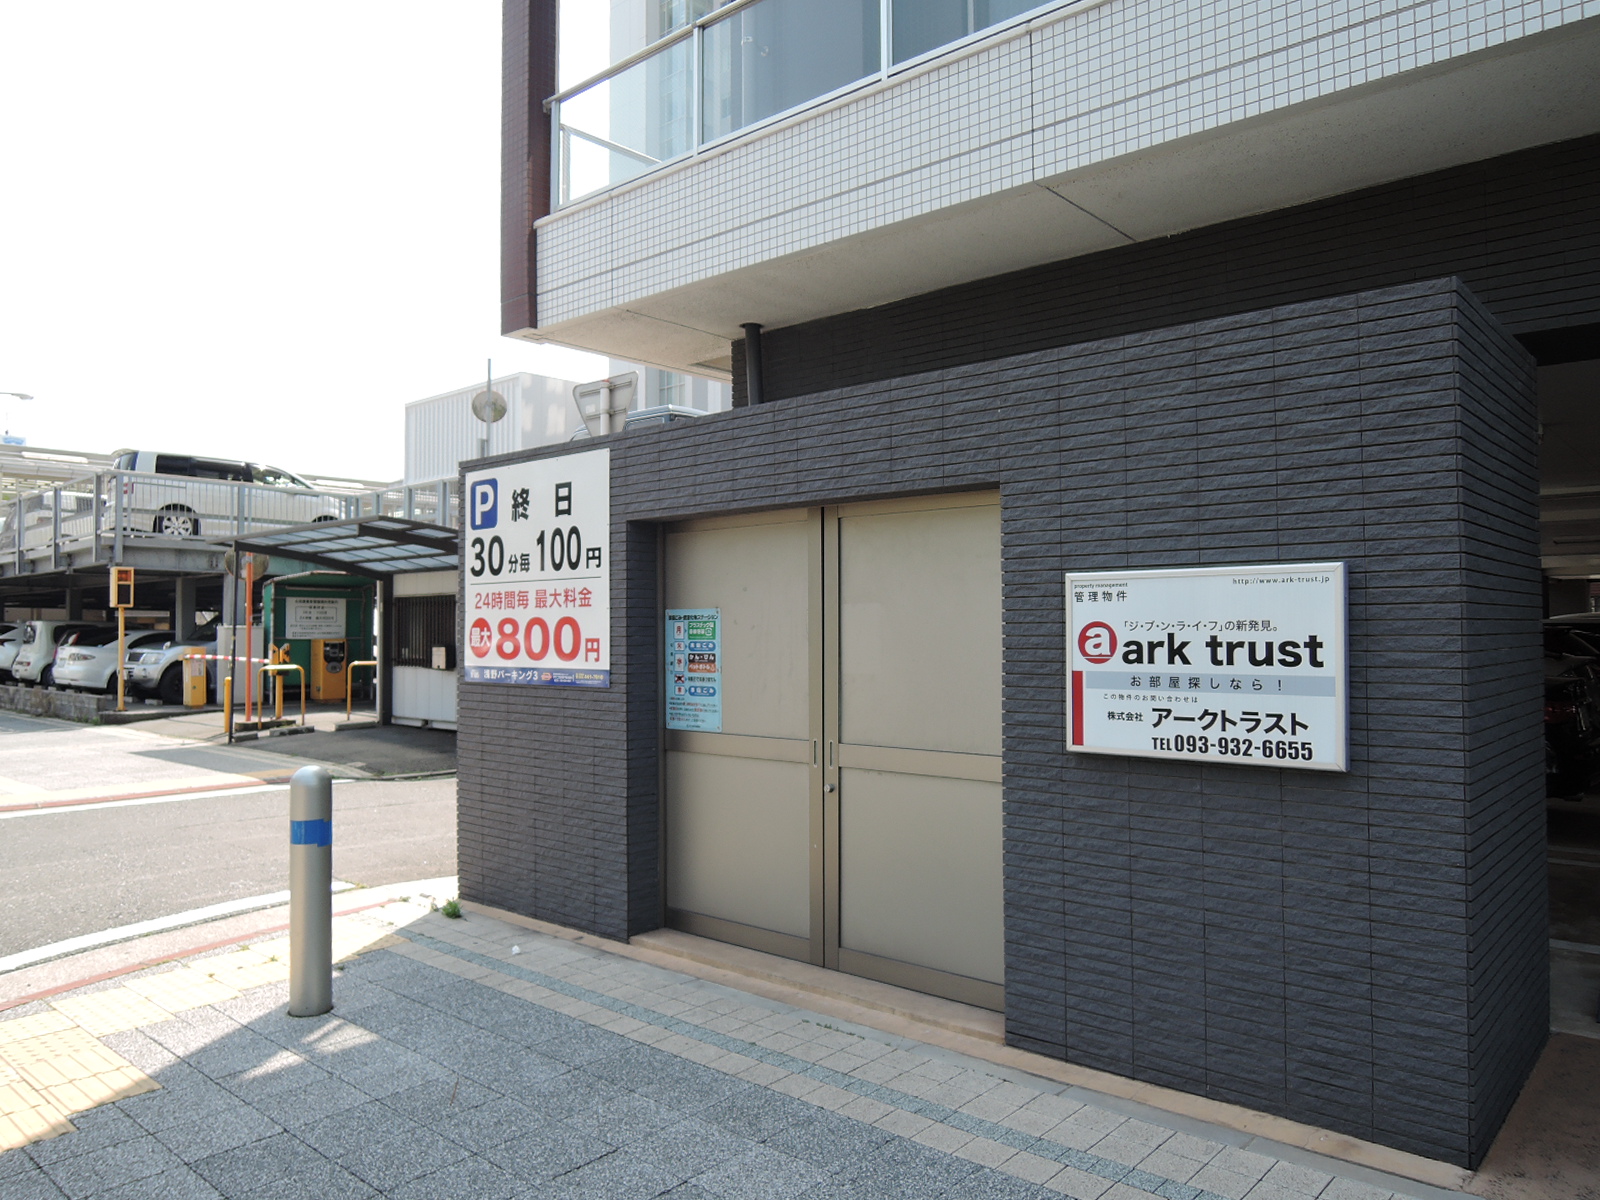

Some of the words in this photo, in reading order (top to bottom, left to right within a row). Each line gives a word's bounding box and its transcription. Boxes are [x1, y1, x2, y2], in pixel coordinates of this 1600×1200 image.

[476, 484, 495, 526] P
[470, 535, 531, 577] 30分毎
[536, 525, 602, 572] 100円
[1232, 576, 1330, 585] http://www.ark-trust.jp
[474, 589, 530, 610] 24時間毎
[534, 587, 593, 609] 最大料金
[1074, 590, 1127, 603] 管理物件
[470, 627, 491, 647] 最大
[496, 616, 601, 662] 800円
[1122, 633, 1192, 666] ark
[1205, 634, 1324, 668] trust
[1103, 693, 1199, 703] この物件のお問い合わせは
[1107, 711, 1144, 722] 株式会社
[1151, 707, 1309, 736] アークトラスト
